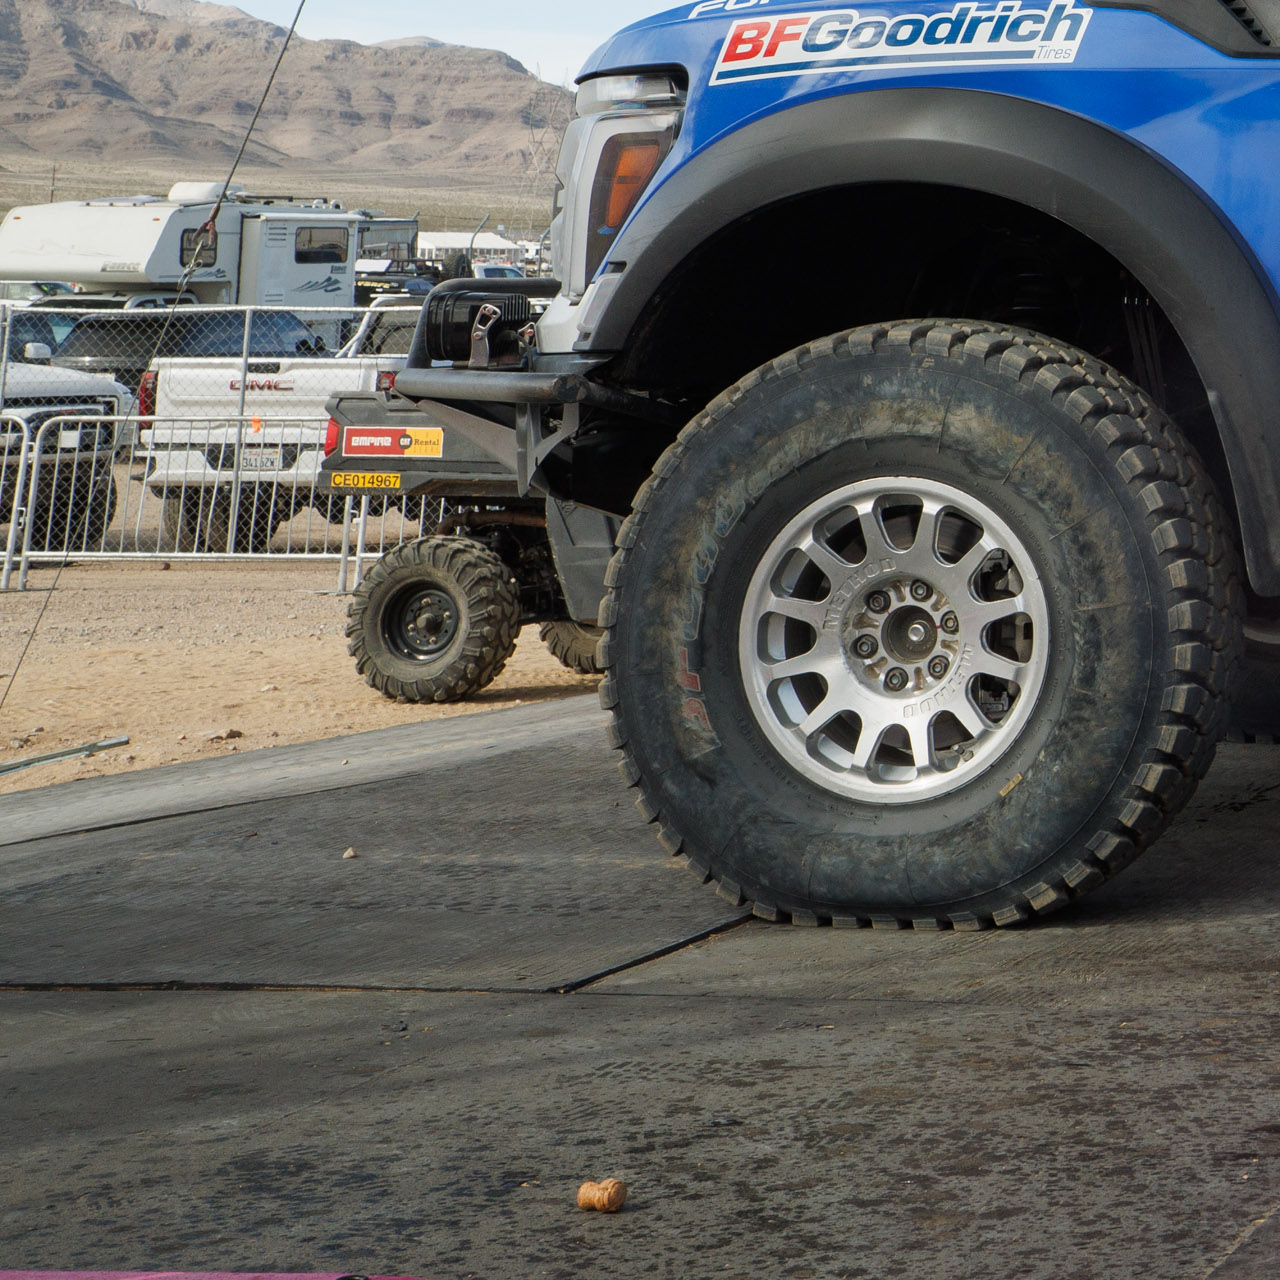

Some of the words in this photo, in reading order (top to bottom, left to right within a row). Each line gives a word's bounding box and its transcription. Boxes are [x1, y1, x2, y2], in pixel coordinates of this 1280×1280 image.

[721, 0, 1078, 64] BFGoodrich
[1037, 44, 1073, 60] Tires
[229, 379, 295, 391] GMC
[414, 438, 440, 447] Rental
[332, 473, 400, 487] CE014967
[822, 557, 897, 632] METHOD
[903, 642, 976, 719] METHOD
